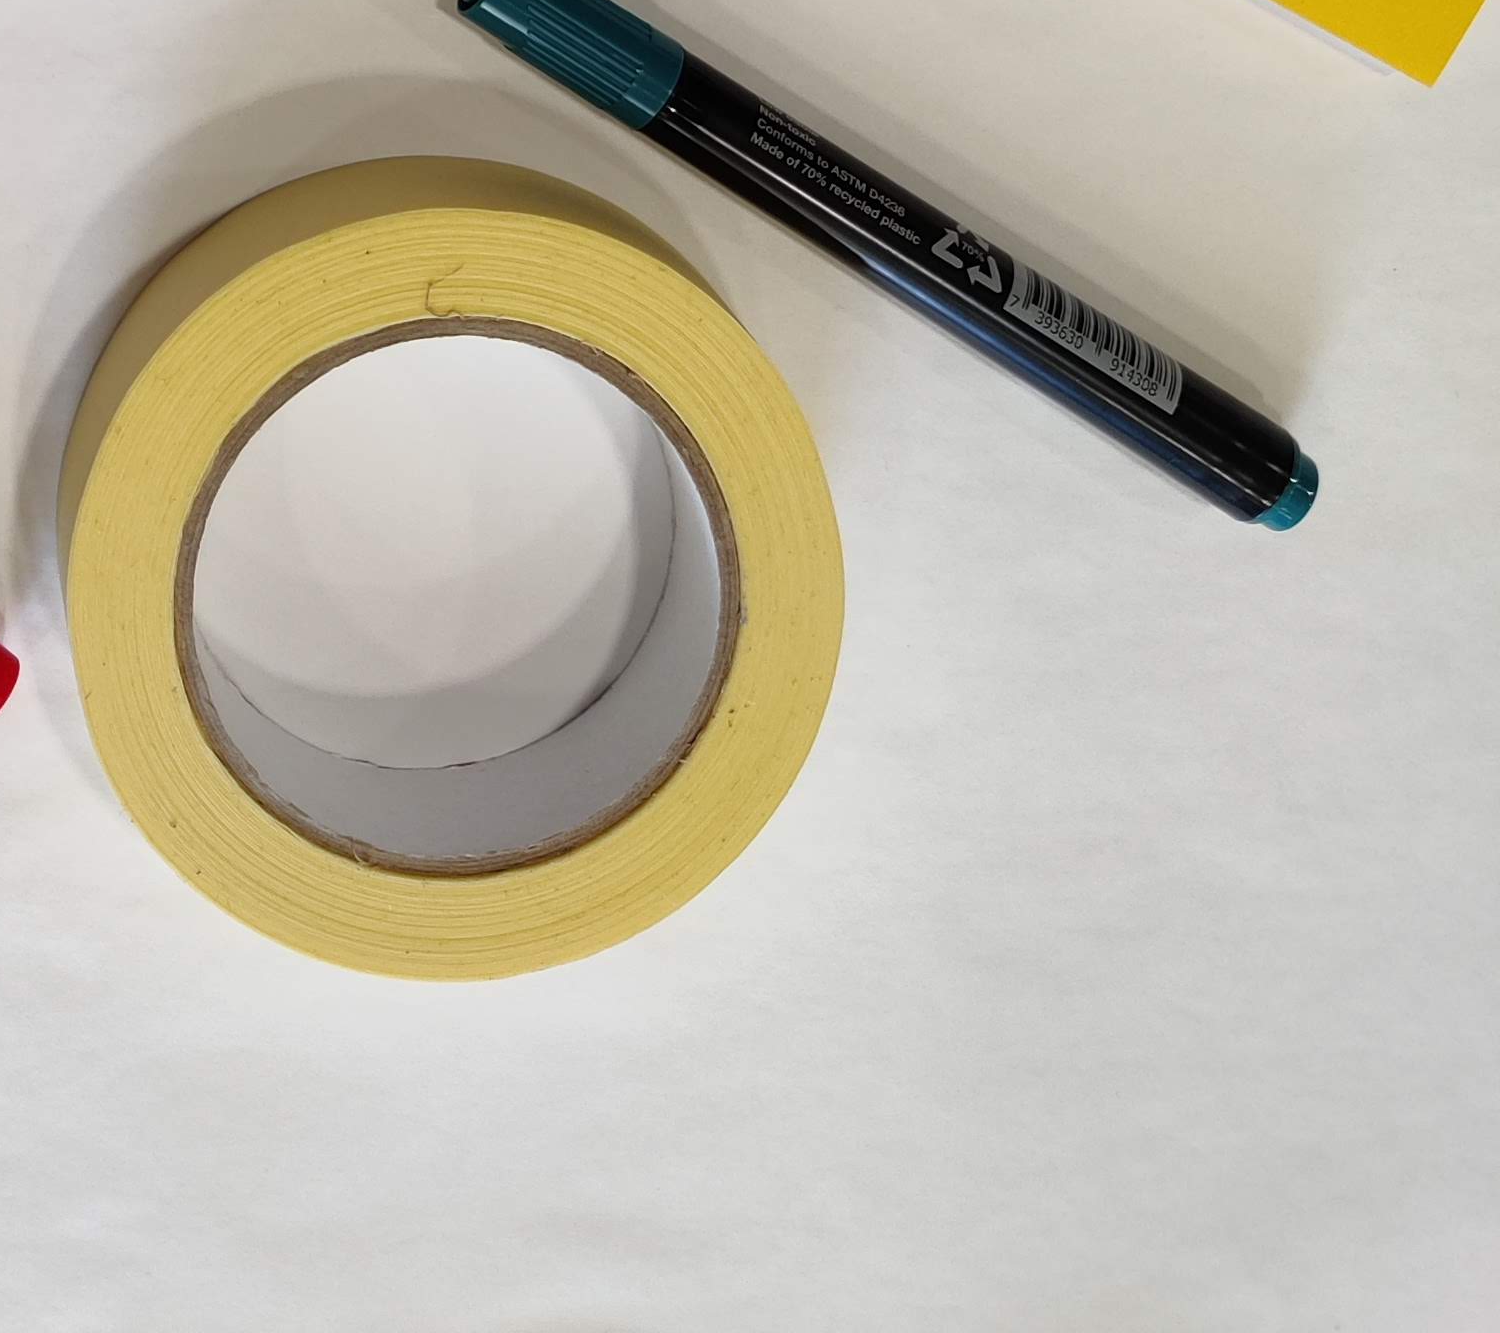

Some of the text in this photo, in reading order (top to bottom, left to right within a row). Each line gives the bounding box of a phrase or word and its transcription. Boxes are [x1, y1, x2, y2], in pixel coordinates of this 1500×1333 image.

[756, 118, 815, 160] Conforms
[831, 165, 867, 193] ASTM
[869, 188, 905, 217] D4236
[760, 105, 817, 146] Non-toxic
[750, 131, 784, 160] Made
[801, 163, 827, 187] 70%
[829, 183, 881, 219] recycled
[879, 216, 921, 245] plastic
[1009, 294, 1161, 397] 7 393630 914308
